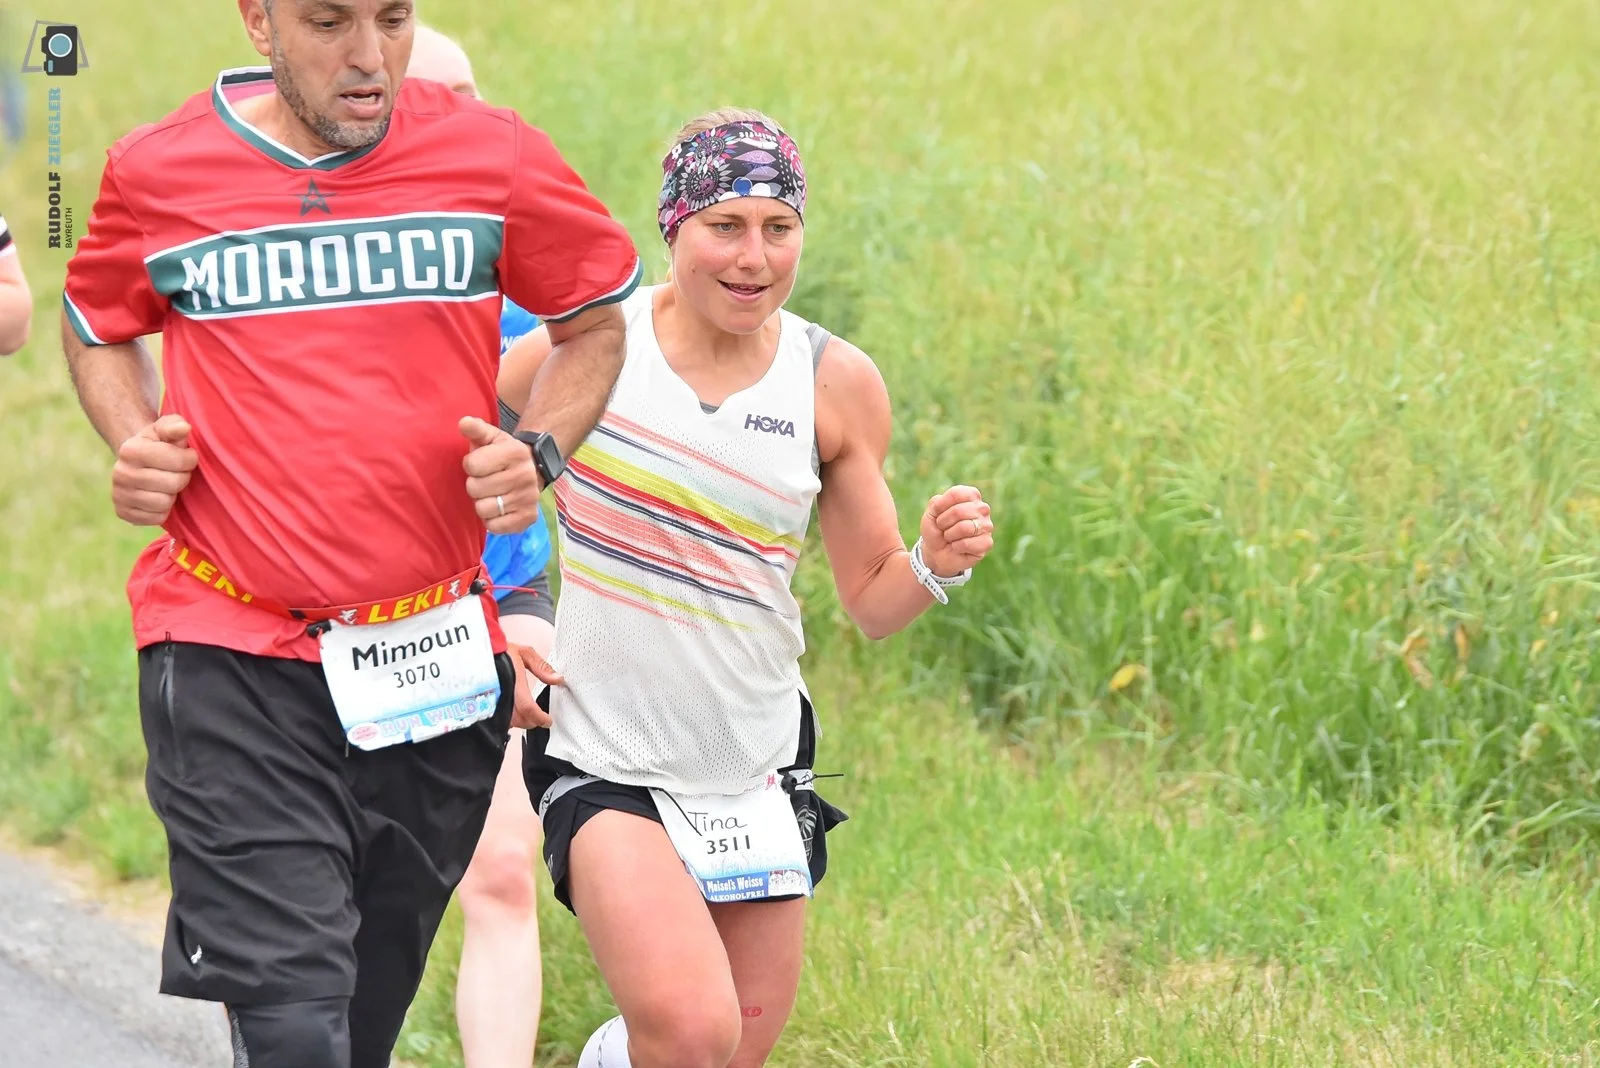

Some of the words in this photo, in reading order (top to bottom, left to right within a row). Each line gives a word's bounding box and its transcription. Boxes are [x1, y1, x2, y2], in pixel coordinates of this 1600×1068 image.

[181, 228, 474, 311] MOROCCO
[744, 413, 795, 438] HOKA
[367, 585, 444, 623] LEKI
[351, 624, 470, 671] Mimoun
[394, 662, 440, 688] 3070
[687, 811, 748, 832] Tina
[706, 835, 750, 855] 3511
